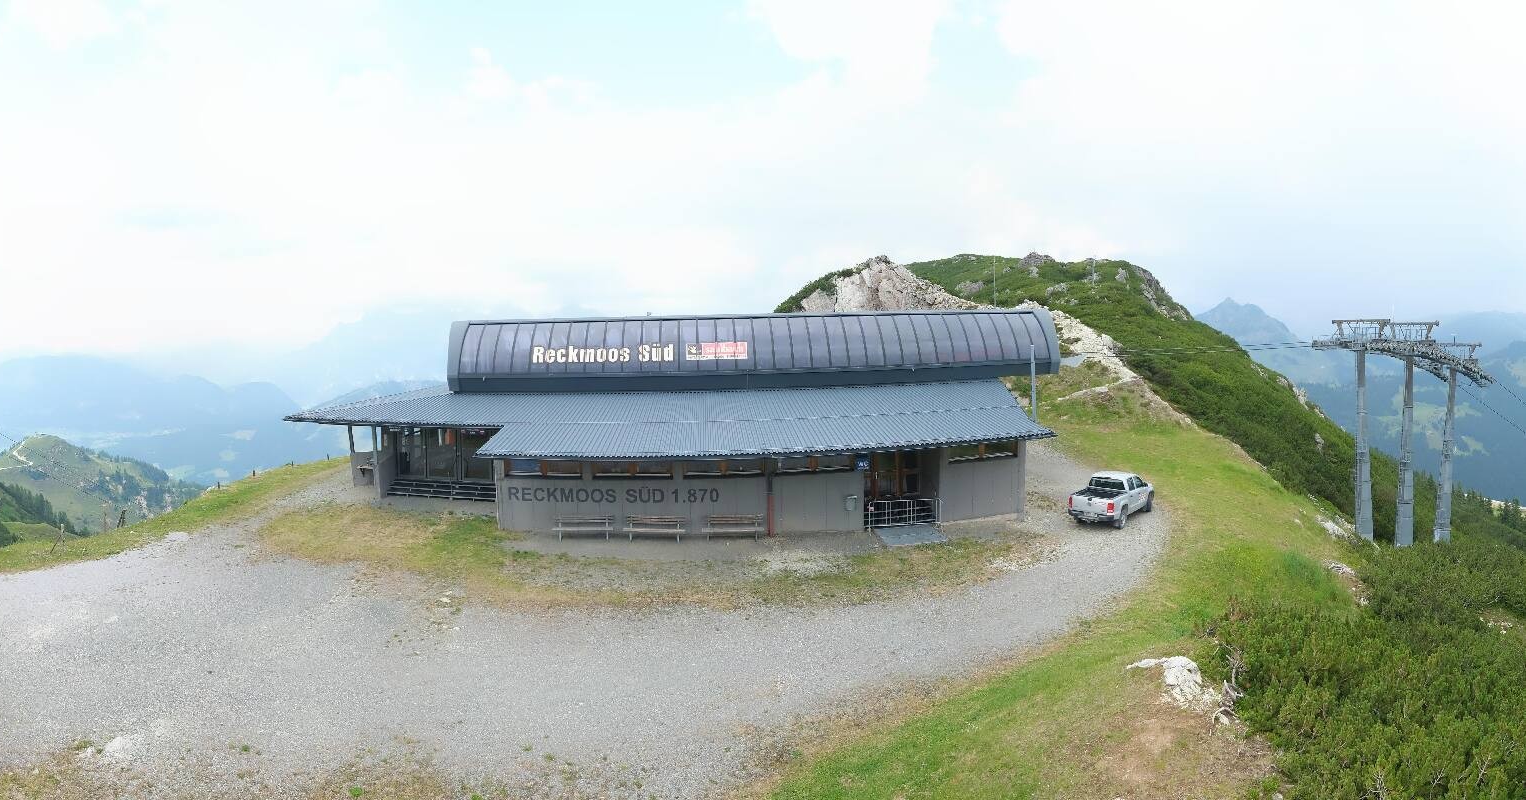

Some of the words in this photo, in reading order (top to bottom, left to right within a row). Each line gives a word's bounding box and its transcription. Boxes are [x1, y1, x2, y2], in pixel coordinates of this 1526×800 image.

[532, 345, 630, 363] Reckmoos
[638, 343, 674, 362] Süd
[508, 486, 617, 503] RECKMOOS
[625, 486, 665, 503] SÜD
[671, 488, 720, 503] 1.870
